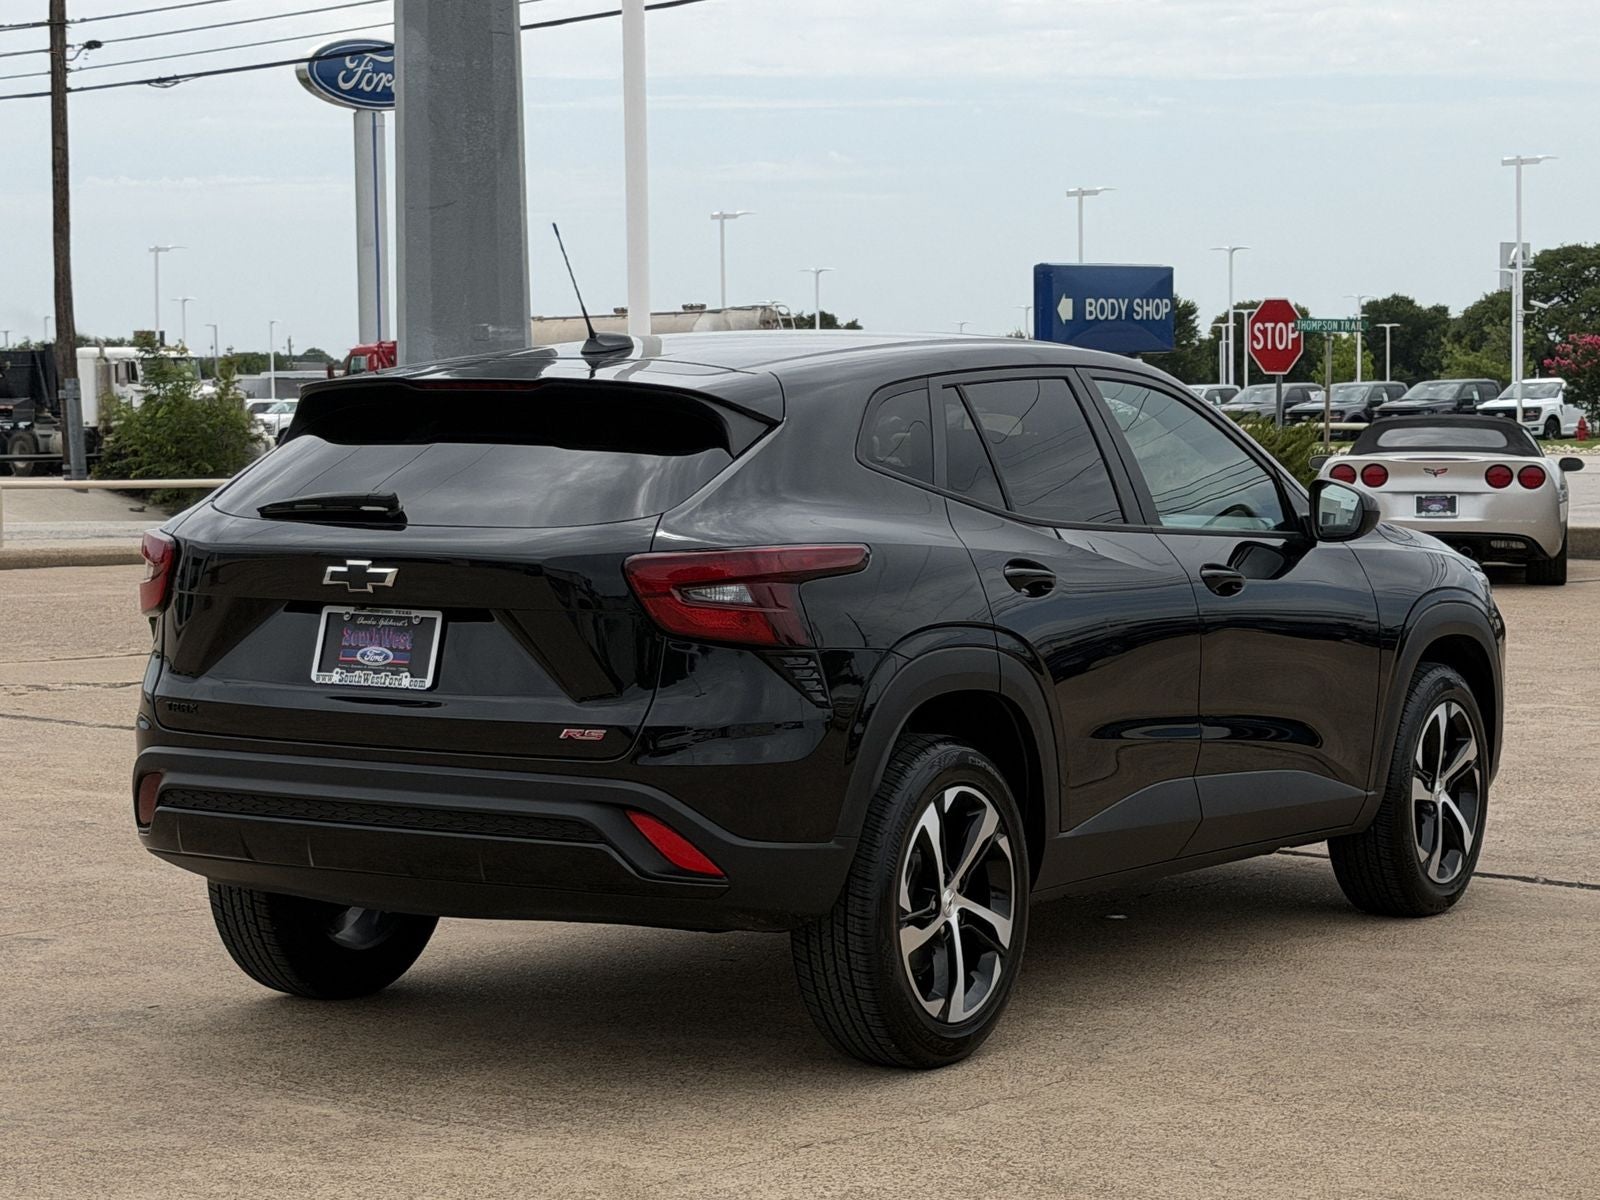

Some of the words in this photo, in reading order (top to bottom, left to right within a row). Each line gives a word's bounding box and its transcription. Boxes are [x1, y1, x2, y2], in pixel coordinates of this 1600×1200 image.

[1085, 298, 1128, 321] BODY
[1132, 298, 1171, 321] SHOP
[1296, 319, 1338, 331] THOMPSON
[1340, 320, 1364, 331] TRAIL
[1252, 321, 1299, 350] STOP
[364, 649, 386, 662] Ford
[559, 728, 607, 740] RS
